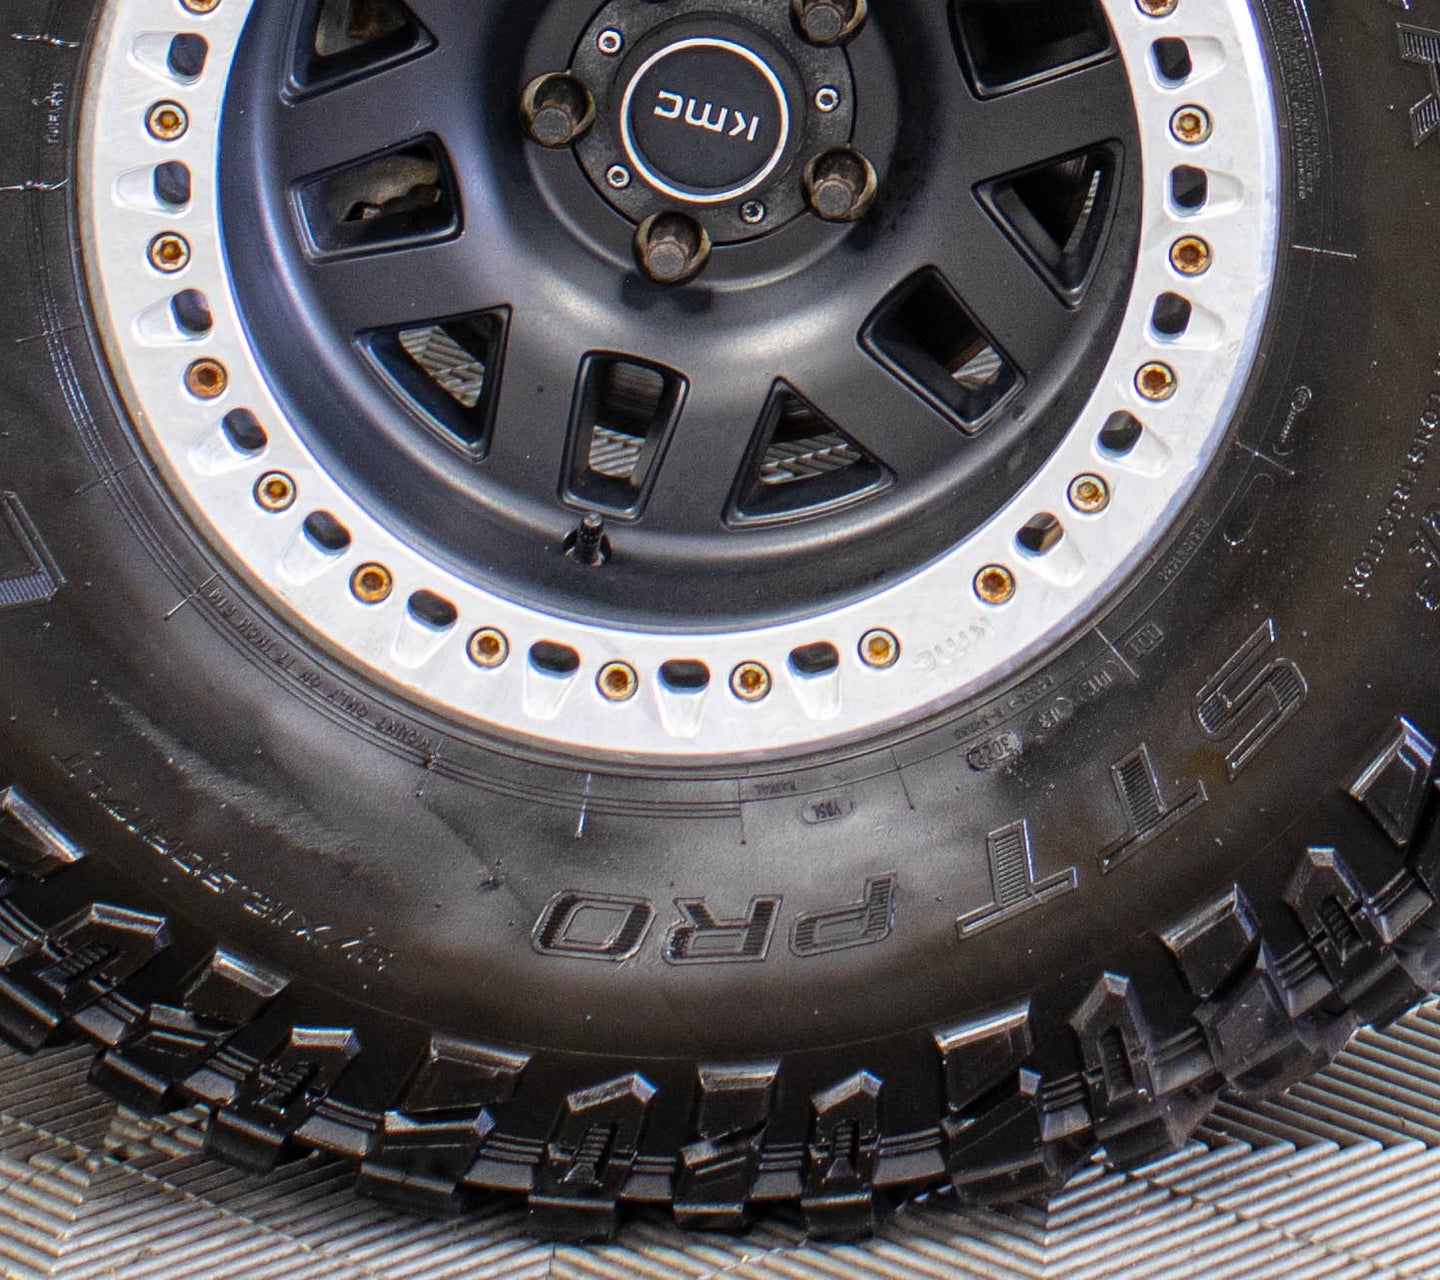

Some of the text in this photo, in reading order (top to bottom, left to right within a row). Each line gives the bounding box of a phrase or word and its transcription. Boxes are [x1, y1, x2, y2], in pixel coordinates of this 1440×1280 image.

[204, 584, 240, 620] RIM
[233, 613, 278, 656] INCH
[296, 664, 326, 692] ON
[323, 682, 372, 722] ONLY
[371, 711, 435, 754] MOUNT
[531, 617, 1316, 965] STT PRO
